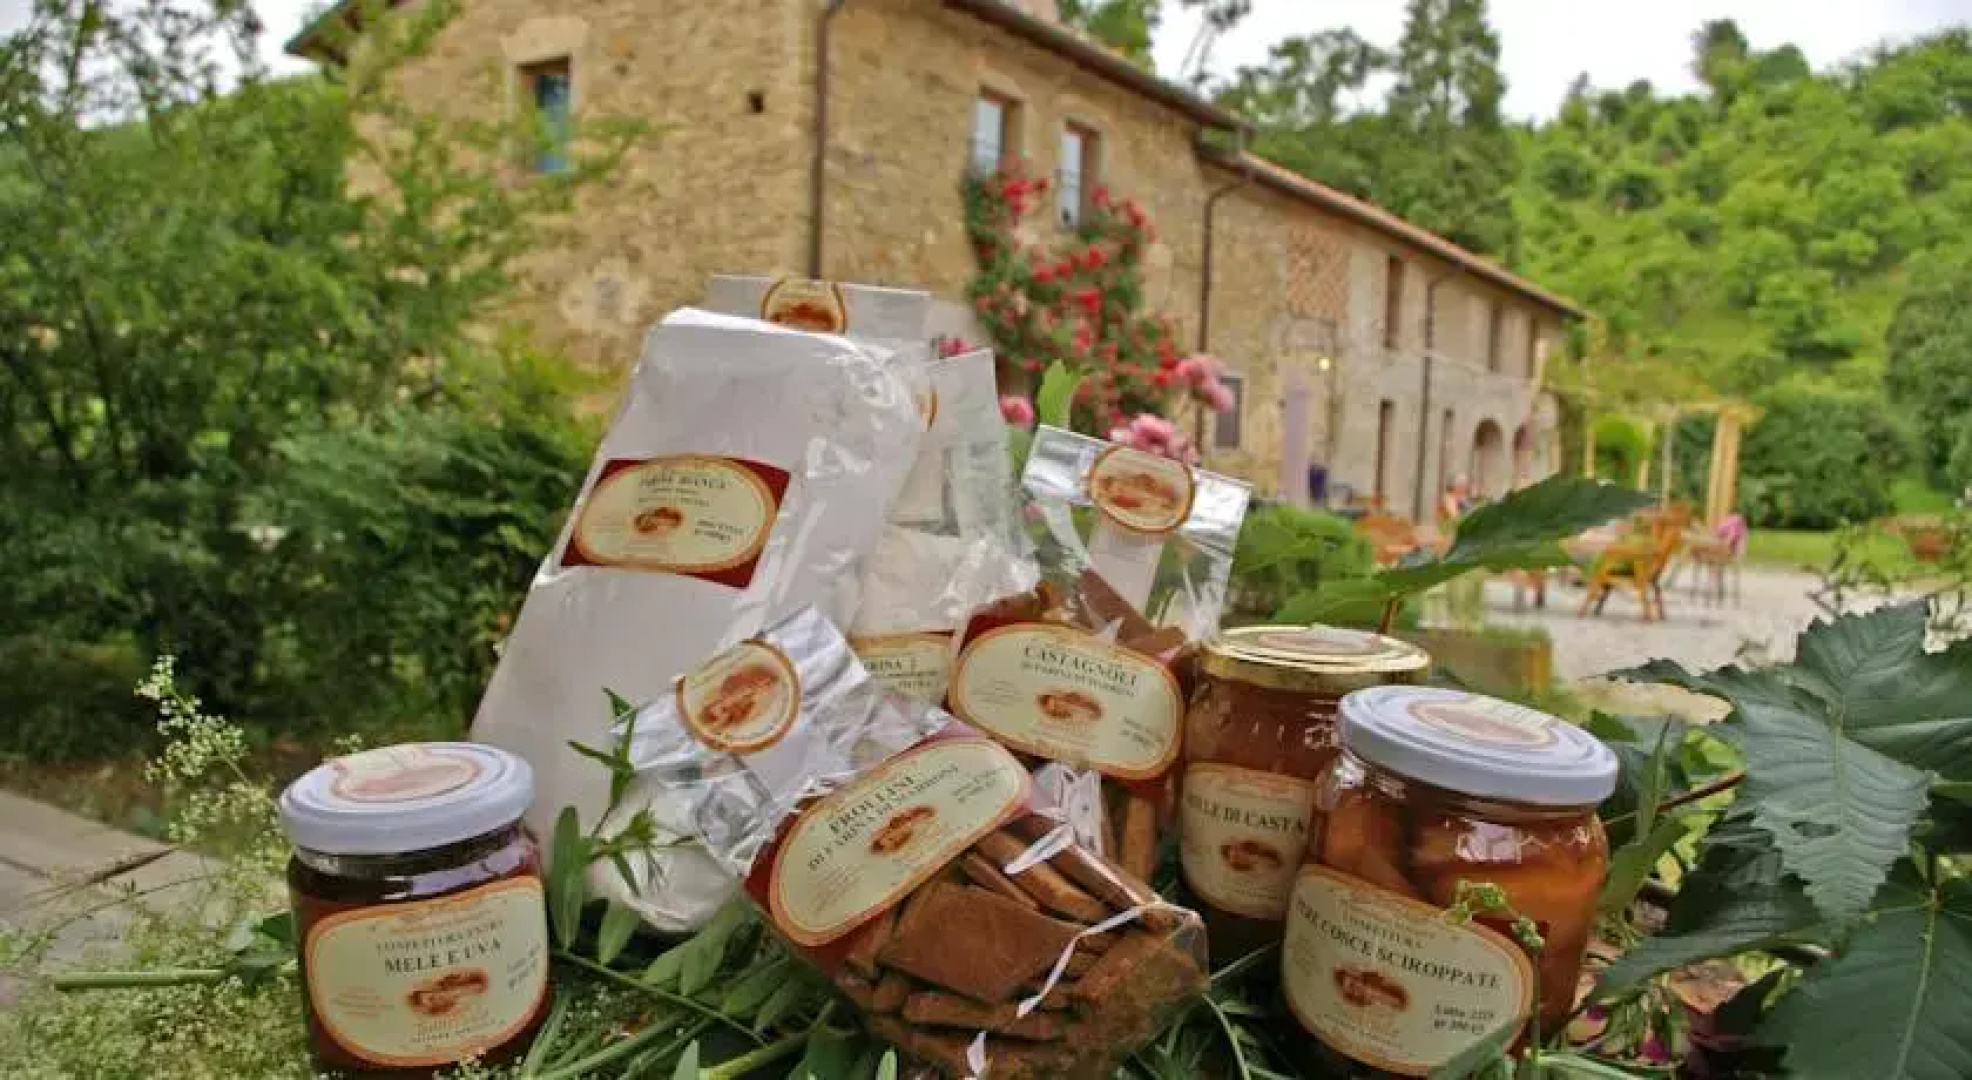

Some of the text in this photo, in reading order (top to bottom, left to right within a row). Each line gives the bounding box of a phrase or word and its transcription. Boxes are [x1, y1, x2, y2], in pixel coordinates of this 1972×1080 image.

[1022, 643, 1138, 689] CASTAGNOLI
[826, 772, 917, 835] FROLLINI
[383, 949, 444, 976] MELE
[447, 949, 462, 966] E
[1374, 947, 1502, 989] SCIROPPATE
